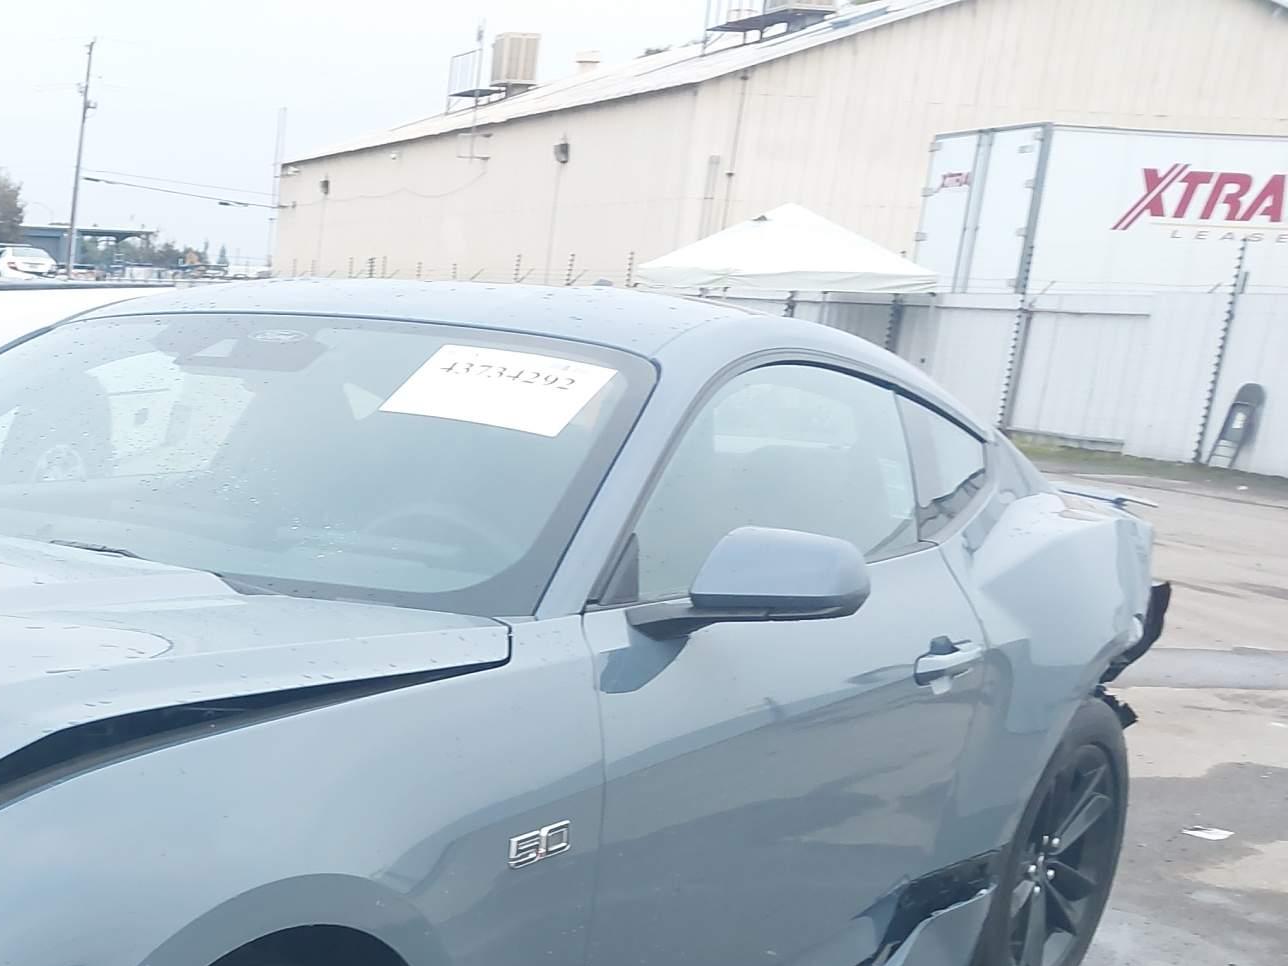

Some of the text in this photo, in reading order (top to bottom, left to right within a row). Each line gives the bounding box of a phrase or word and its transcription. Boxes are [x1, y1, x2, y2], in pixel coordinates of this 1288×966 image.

[1111, 163, 1287, 230] XTRA
[1170, 230, 1288, 243] LEASE
[440, 361, 575, 390] 43734292
